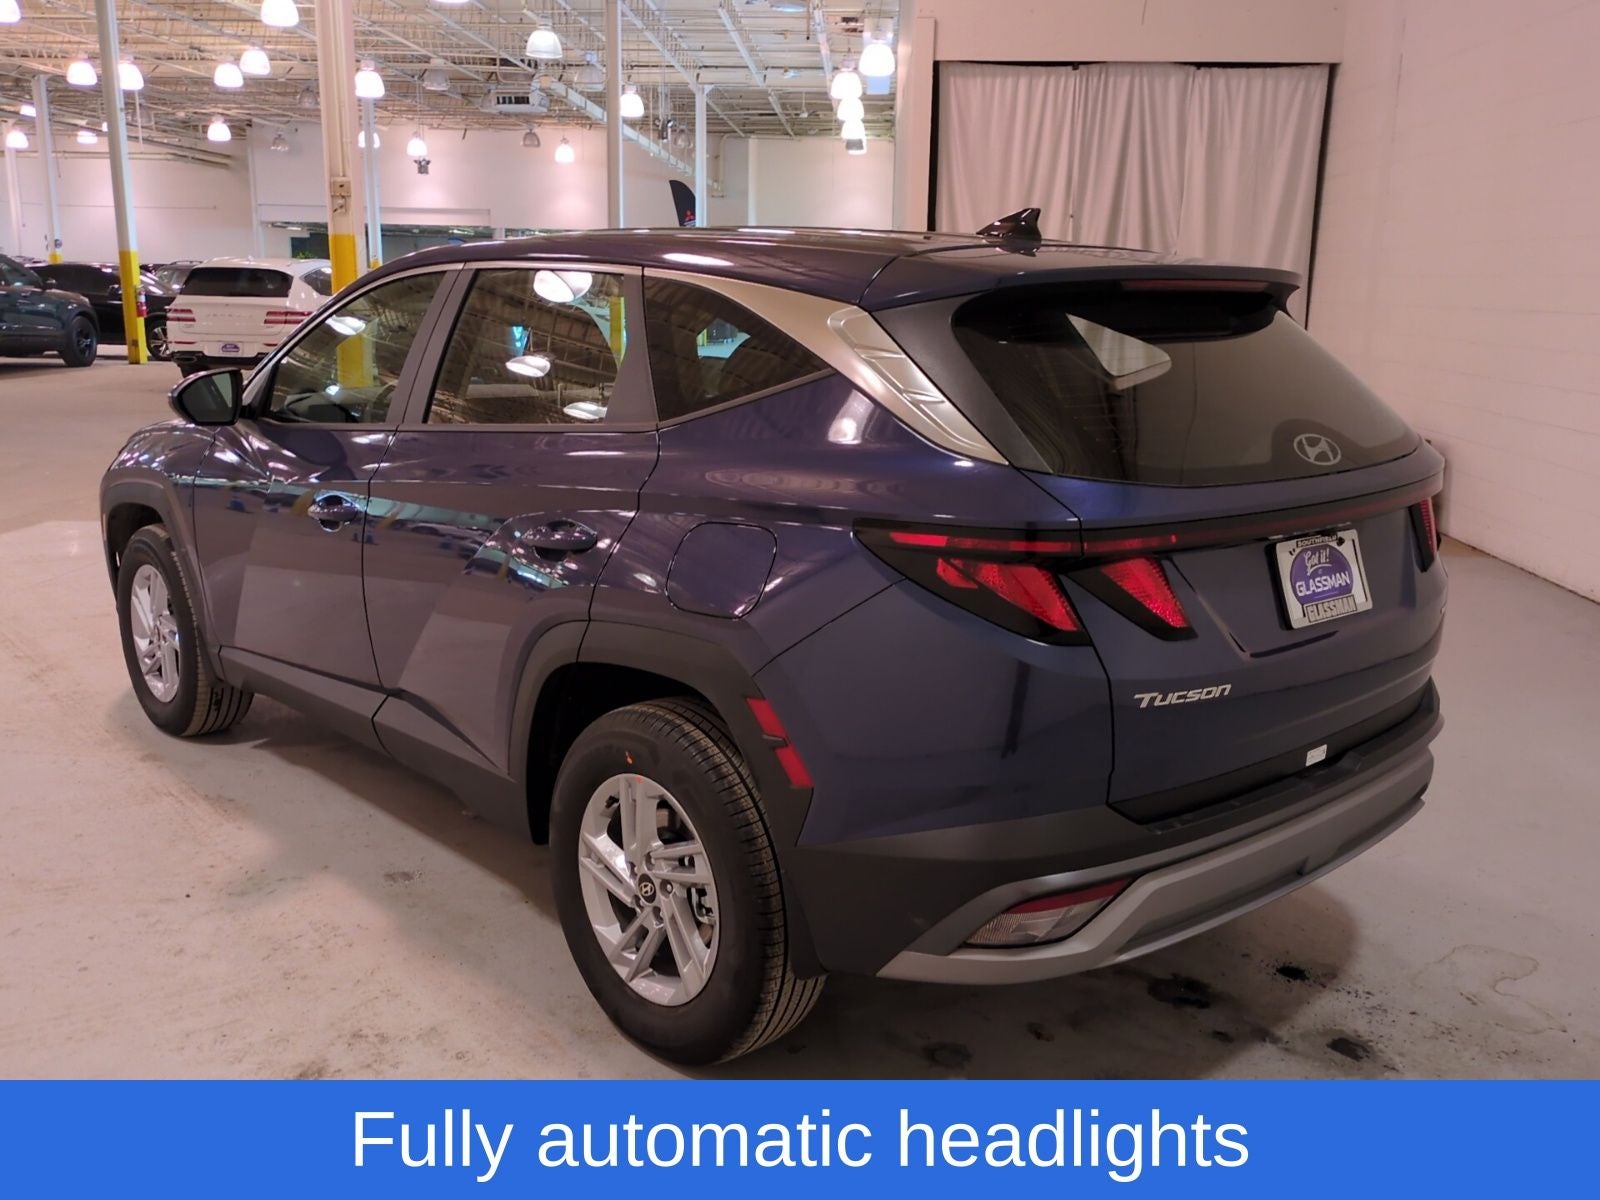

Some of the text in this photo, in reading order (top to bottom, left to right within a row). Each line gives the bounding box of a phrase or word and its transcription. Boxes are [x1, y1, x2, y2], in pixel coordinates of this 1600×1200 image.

[1303, 550, 1320, 568] Got
[1296, 571, 1351, 597] GLASSMAN
[1307, 596, 1357, 621] GLASSMAN
